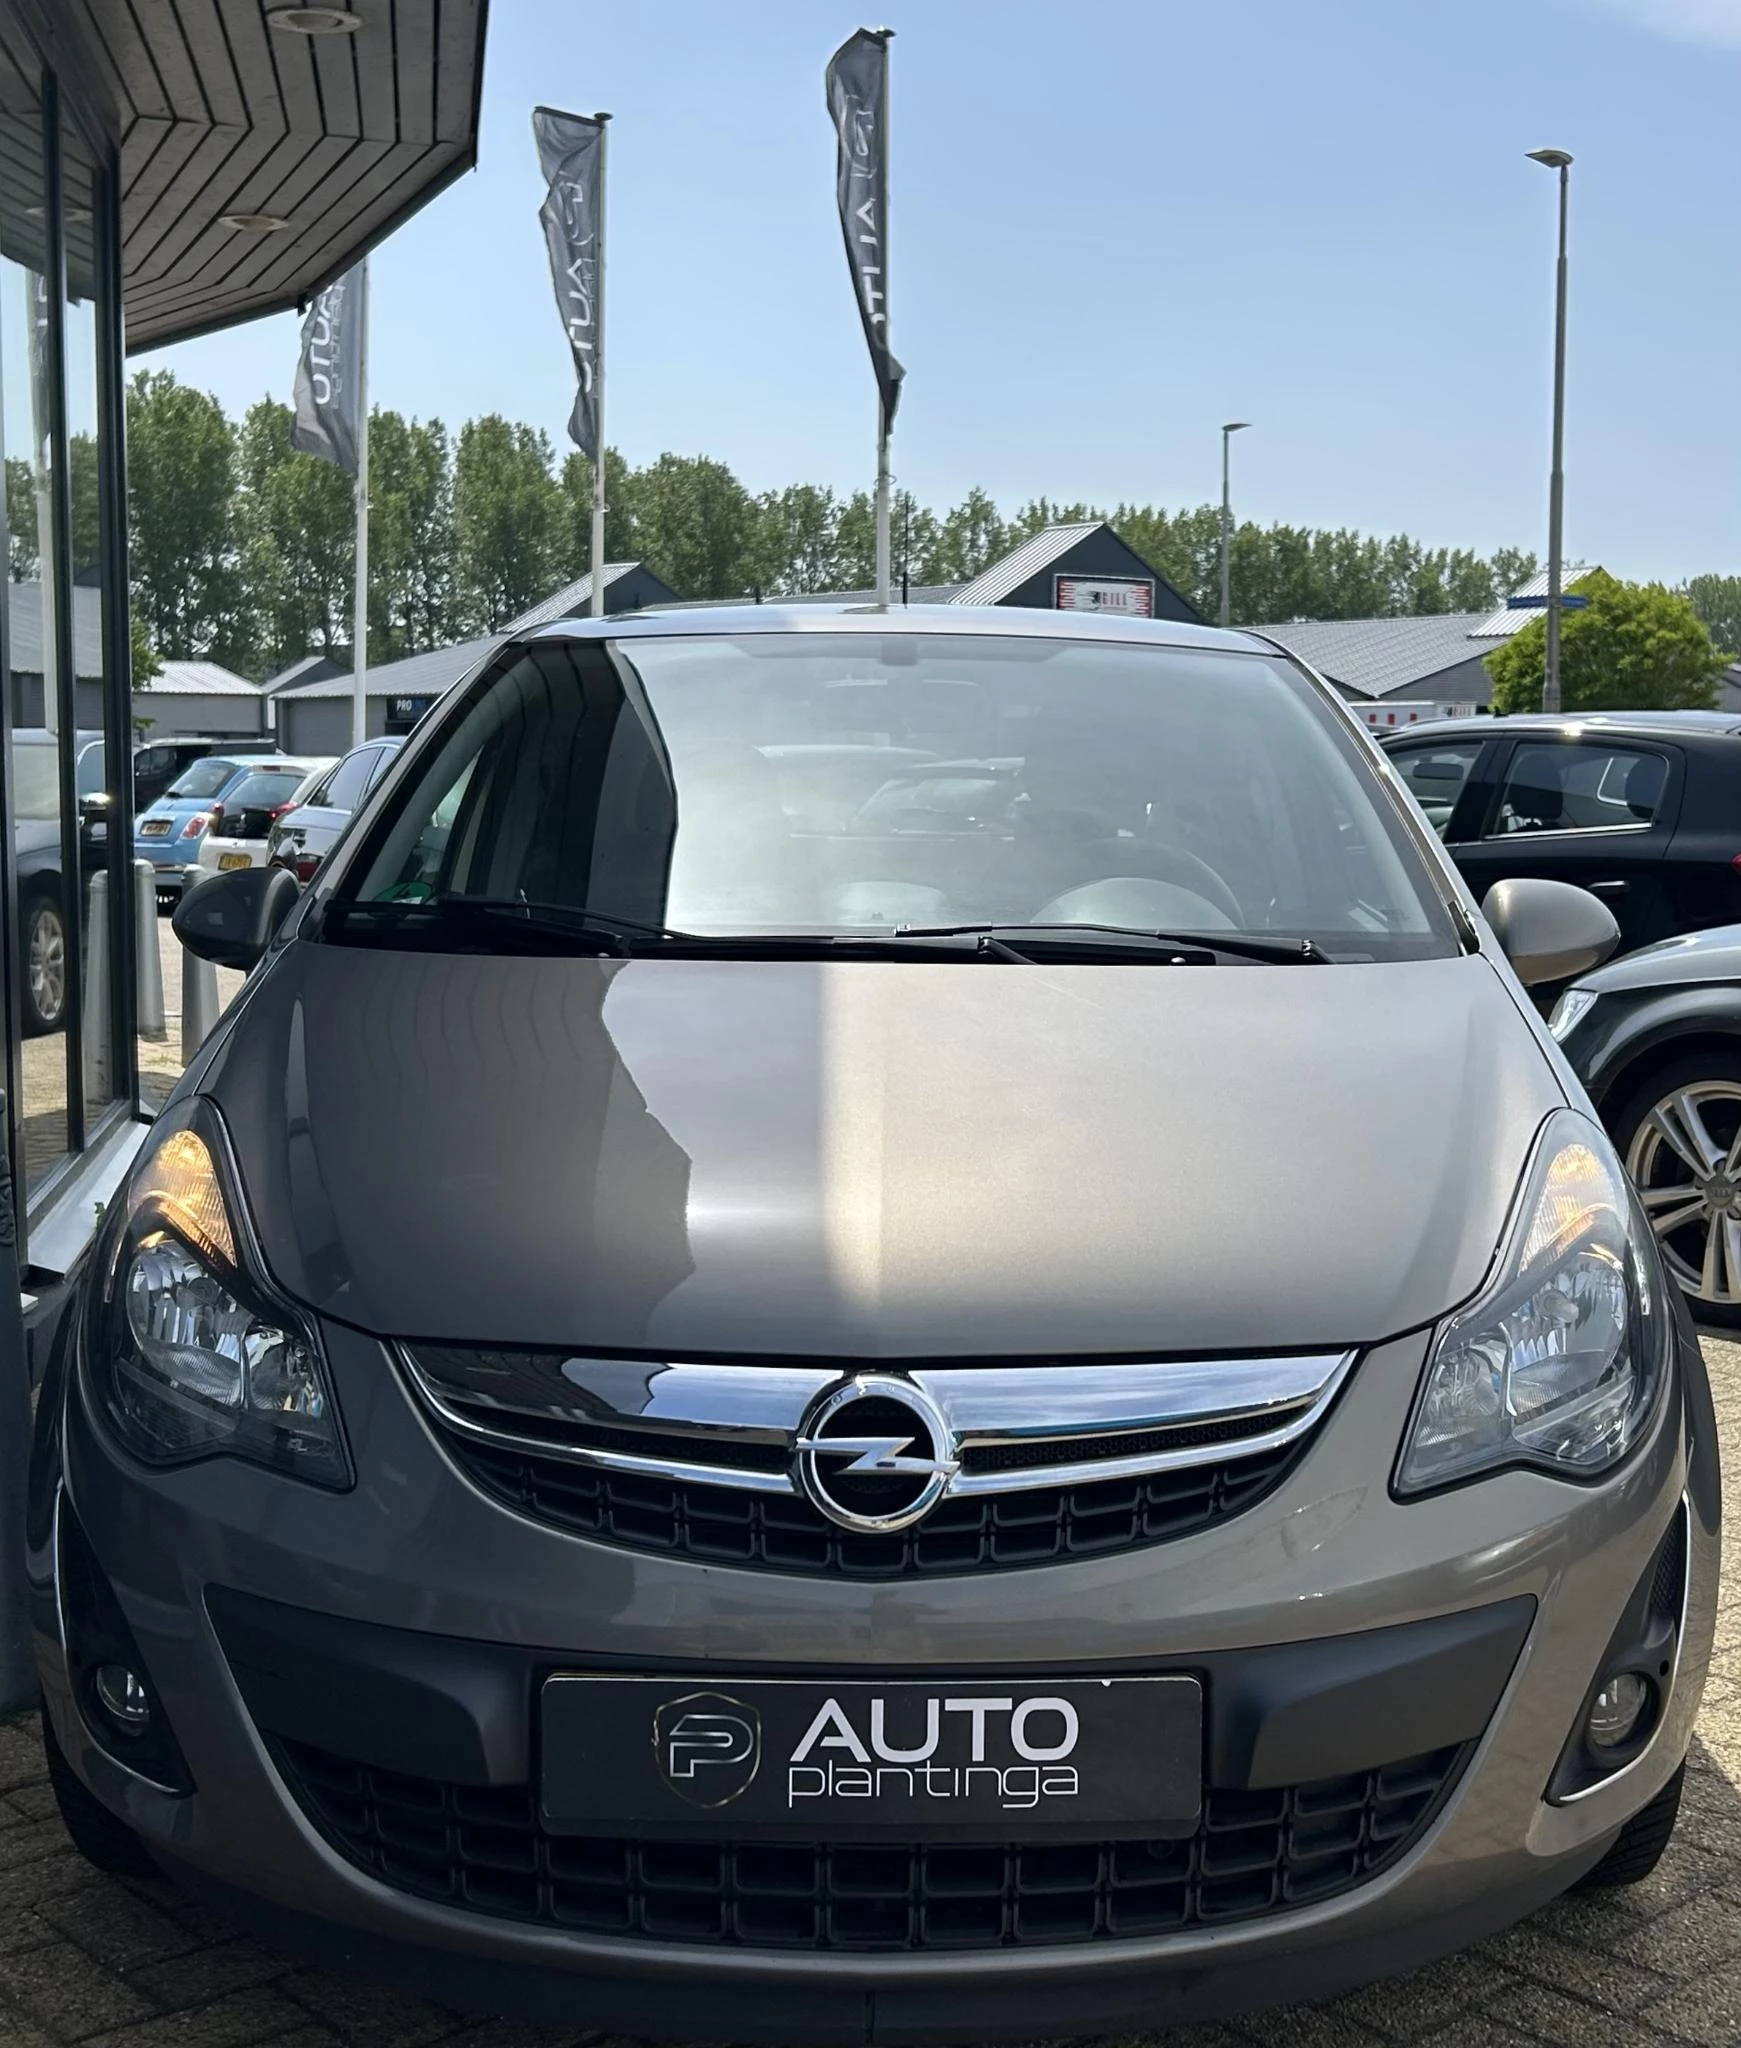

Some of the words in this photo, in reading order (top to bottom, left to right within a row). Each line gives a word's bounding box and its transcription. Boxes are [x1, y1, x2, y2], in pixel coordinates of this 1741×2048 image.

[396, 699, 413, 712] PRO
[789, 1697, 1079, 1763] AUTO
[788, 1760, 1079, 1809] plantinga
